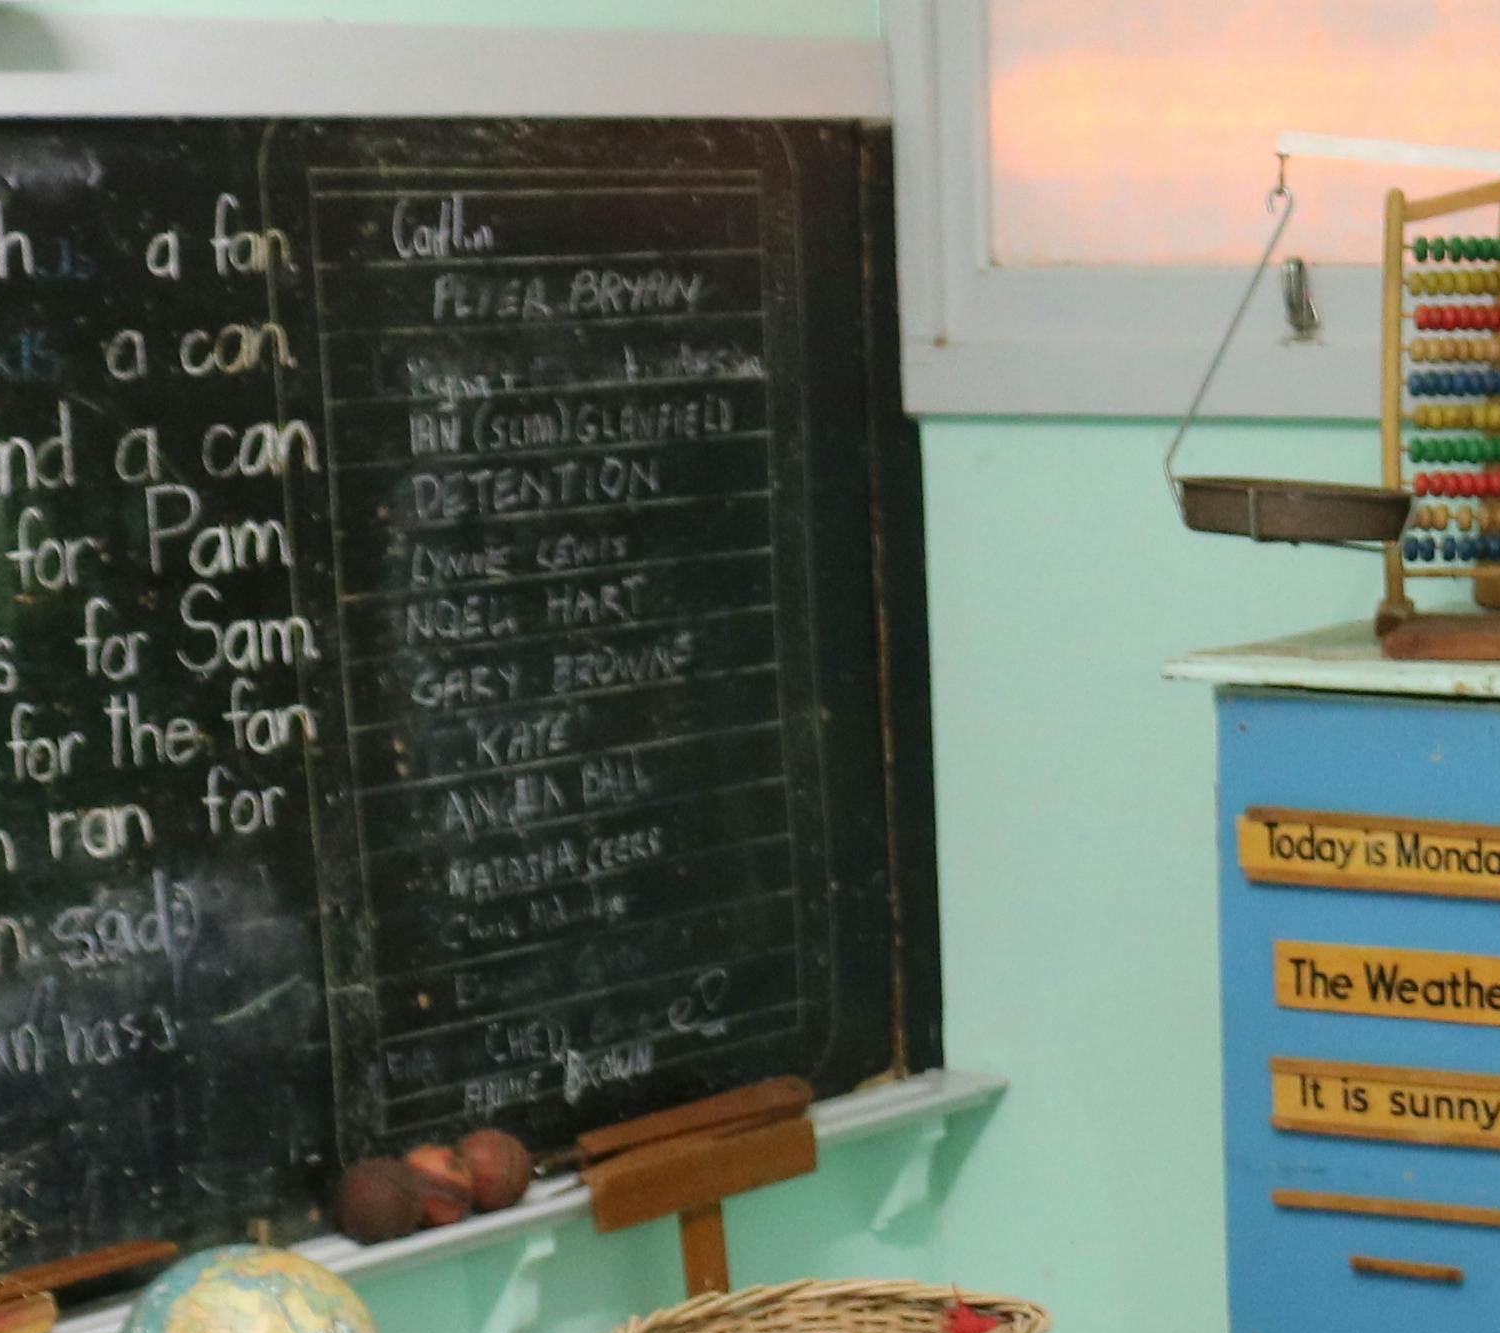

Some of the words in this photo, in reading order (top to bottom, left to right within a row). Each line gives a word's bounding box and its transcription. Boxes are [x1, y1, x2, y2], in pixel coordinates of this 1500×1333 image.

[146, 230, 180, 280] a
[105, 328, 147, 382] a
[114, 426, 162, 485] a
[202, 418, 321, 479] can
[410, 456, 662, 523] DETENTION
[5, 506, 100, 591] for
[145, 482, 296, 578] Pam
[75, 595, 153, 681] for
[6, 701, 87, 784] for
[102, 692, 201, 770] the
[222, 676, 319, 756] fan
[47, 799, 155, 861] ran
[201, 763, 288, 835] for
[1263, 820, 1356, 870] Today
[1362, 829, 1388, 868] is
[1288, 956, 1354, 1000] The
[1298, 1074, 1326, 1110] It
[1341, 1076, 1369, 1113] is
